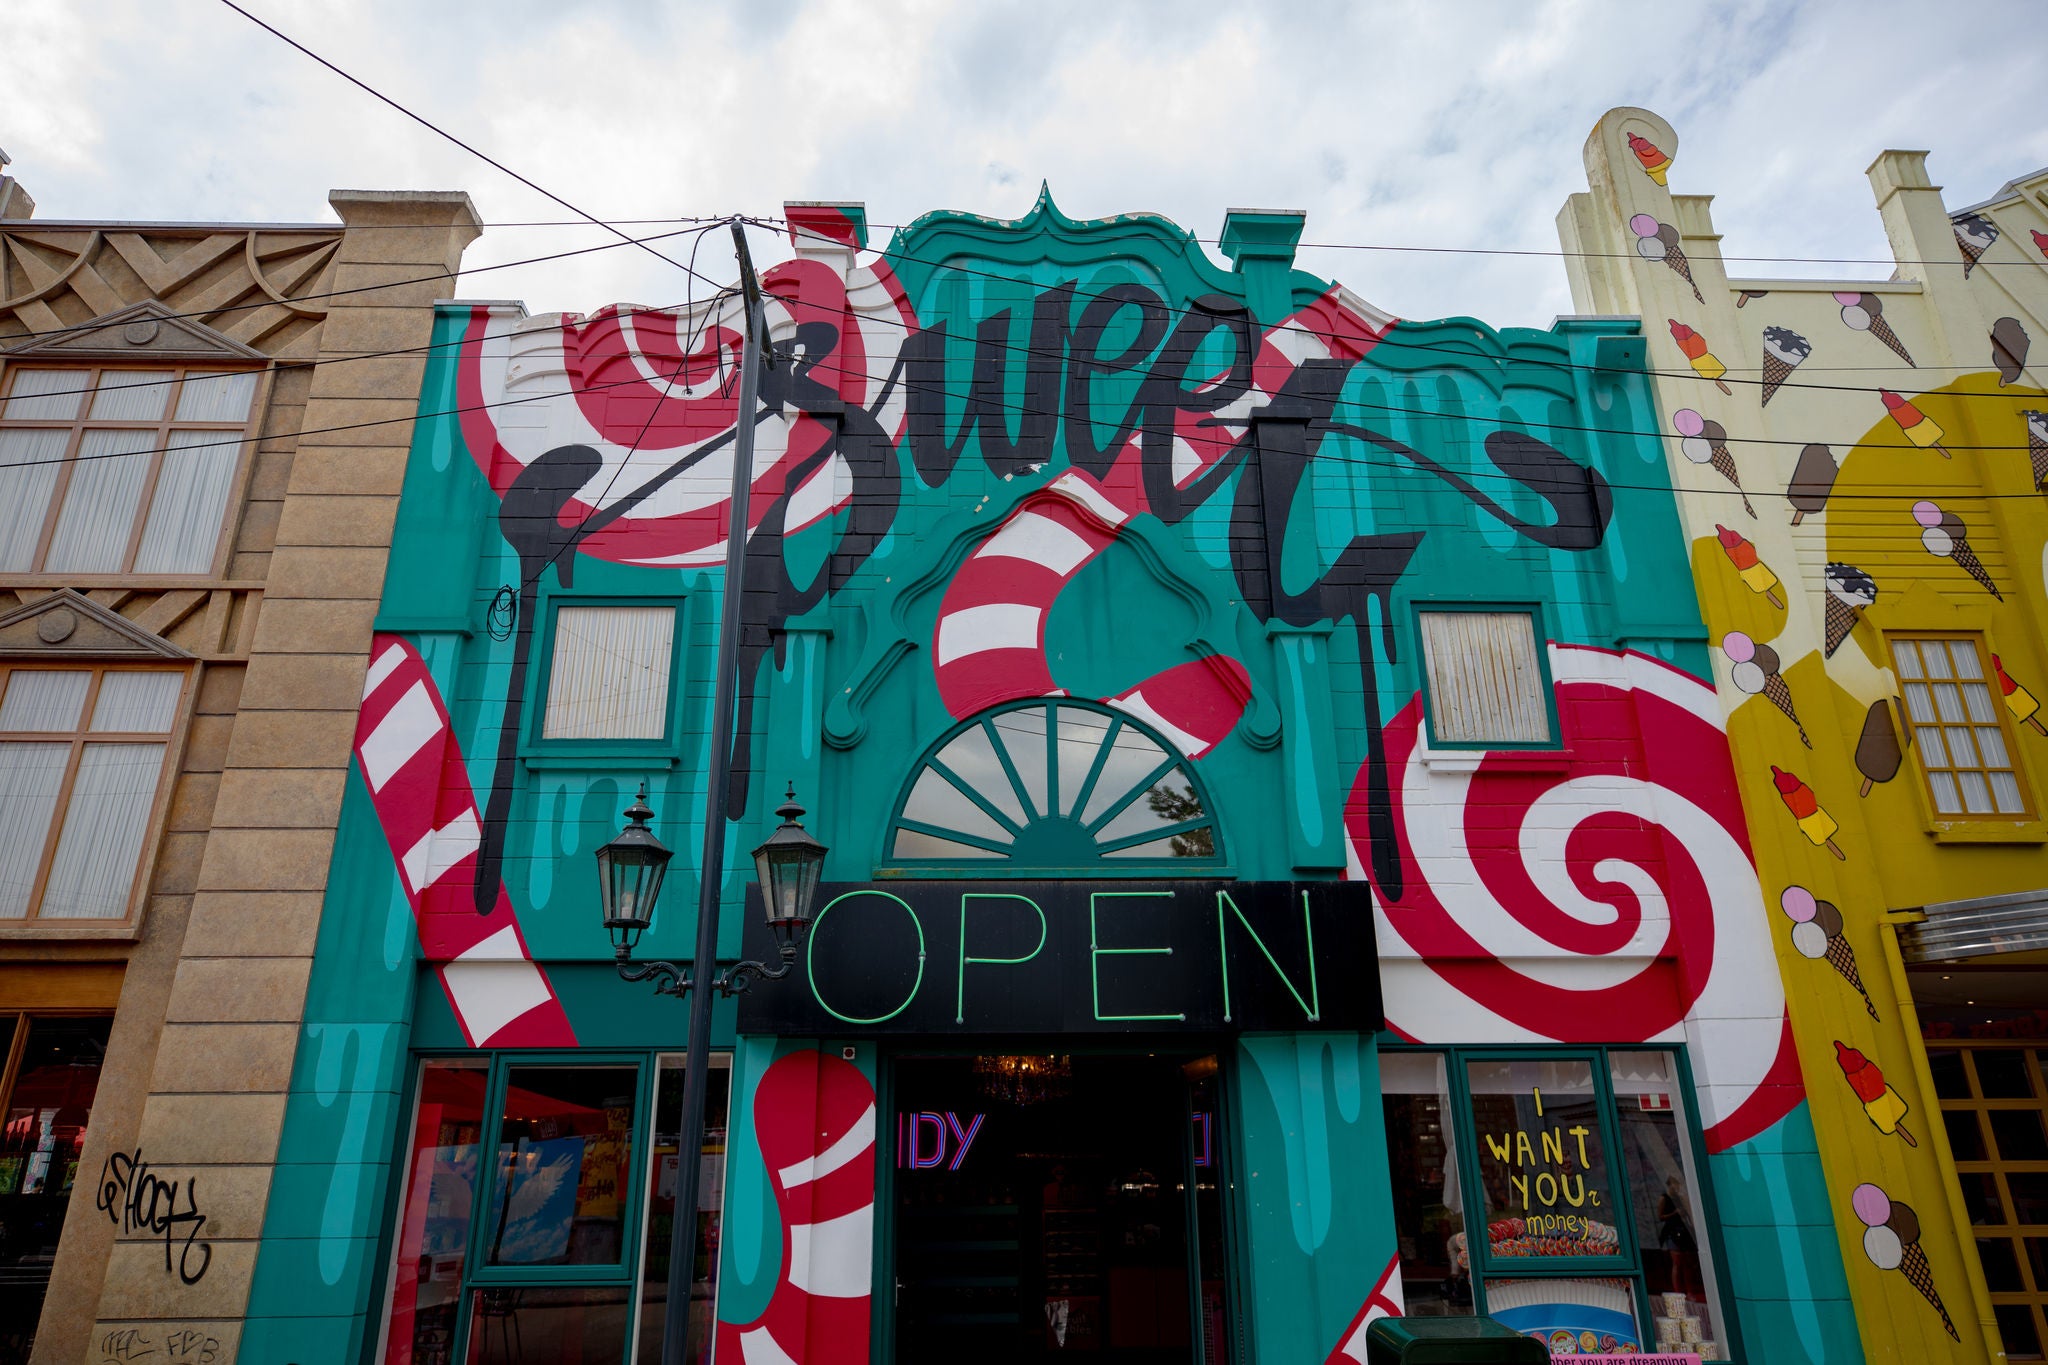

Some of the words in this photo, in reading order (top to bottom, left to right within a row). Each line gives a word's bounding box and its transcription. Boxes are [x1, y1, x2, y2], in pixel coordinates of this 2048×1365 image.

[807, 889, 1321, 1025] OPEN
[1533, 1086, 1543, 1118] I
[897, 1111, 987, 1172] DY
[1485, 1125, 1591, 1169] WANT
[1525, 1213, 1590, 1241] money
